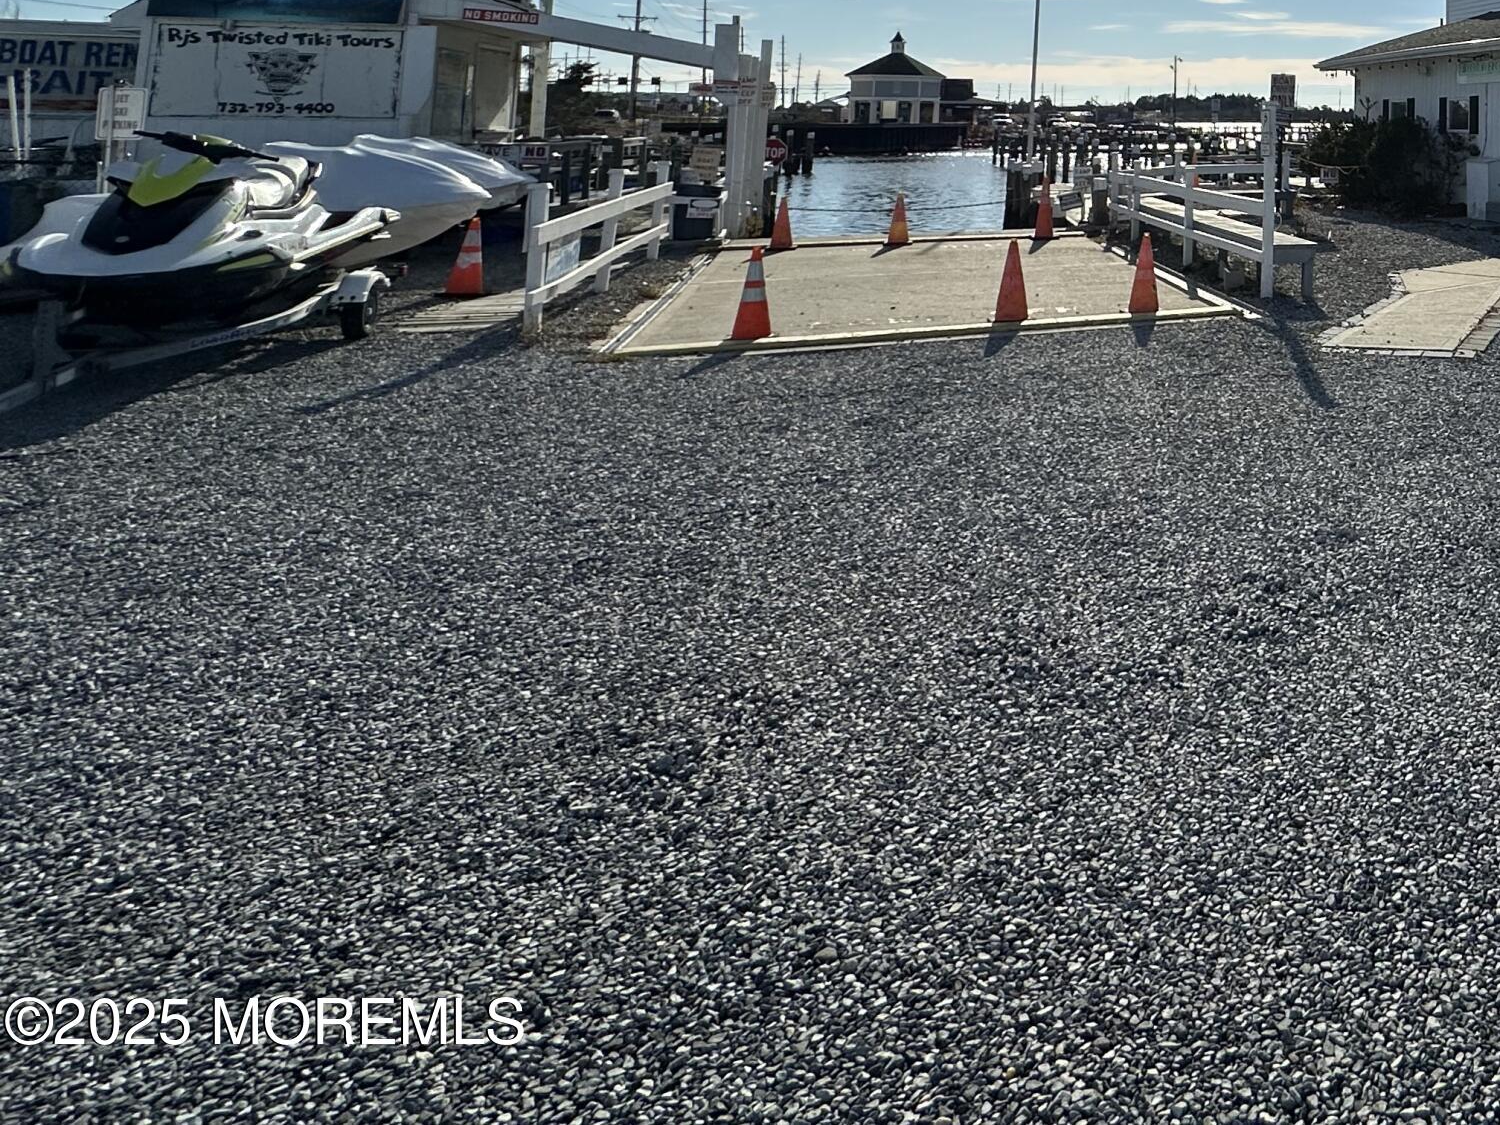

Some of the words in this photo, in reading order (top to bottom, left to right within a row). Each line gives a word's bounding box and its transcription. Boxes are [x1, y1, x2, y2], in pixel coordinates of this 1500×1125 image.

[464, 10, 480, 19] NO
[484, 11, 537, 23] SMOKING
[207, 30, 287, 45] Twisted
[292, 32, 332, 47] Tiki
[336, 34, 395, 49] Tours
[0, 38, 75, 66] BOAT
[525, 146, 546, 157] NO
[765, 147, 785, 158] TOP
